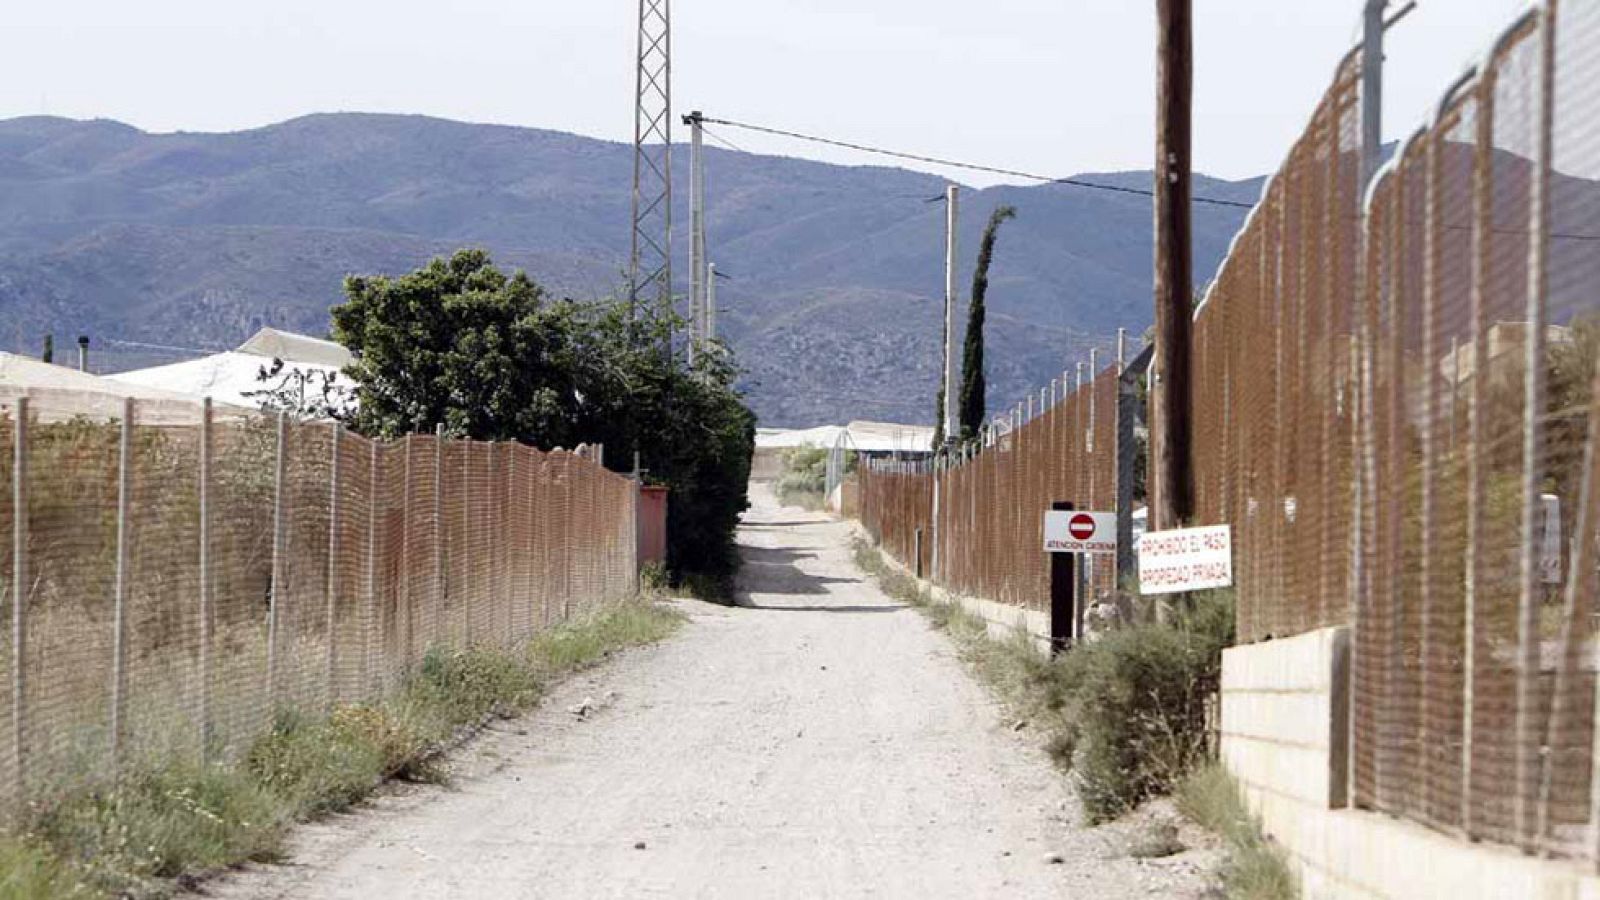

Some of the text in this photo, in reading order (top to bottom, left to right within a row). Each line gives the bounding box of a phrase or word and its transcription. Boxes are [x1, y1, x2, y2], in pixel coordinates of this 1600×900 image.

[1141, 531, 1227, 556] PROHIBIDO EL PASO
